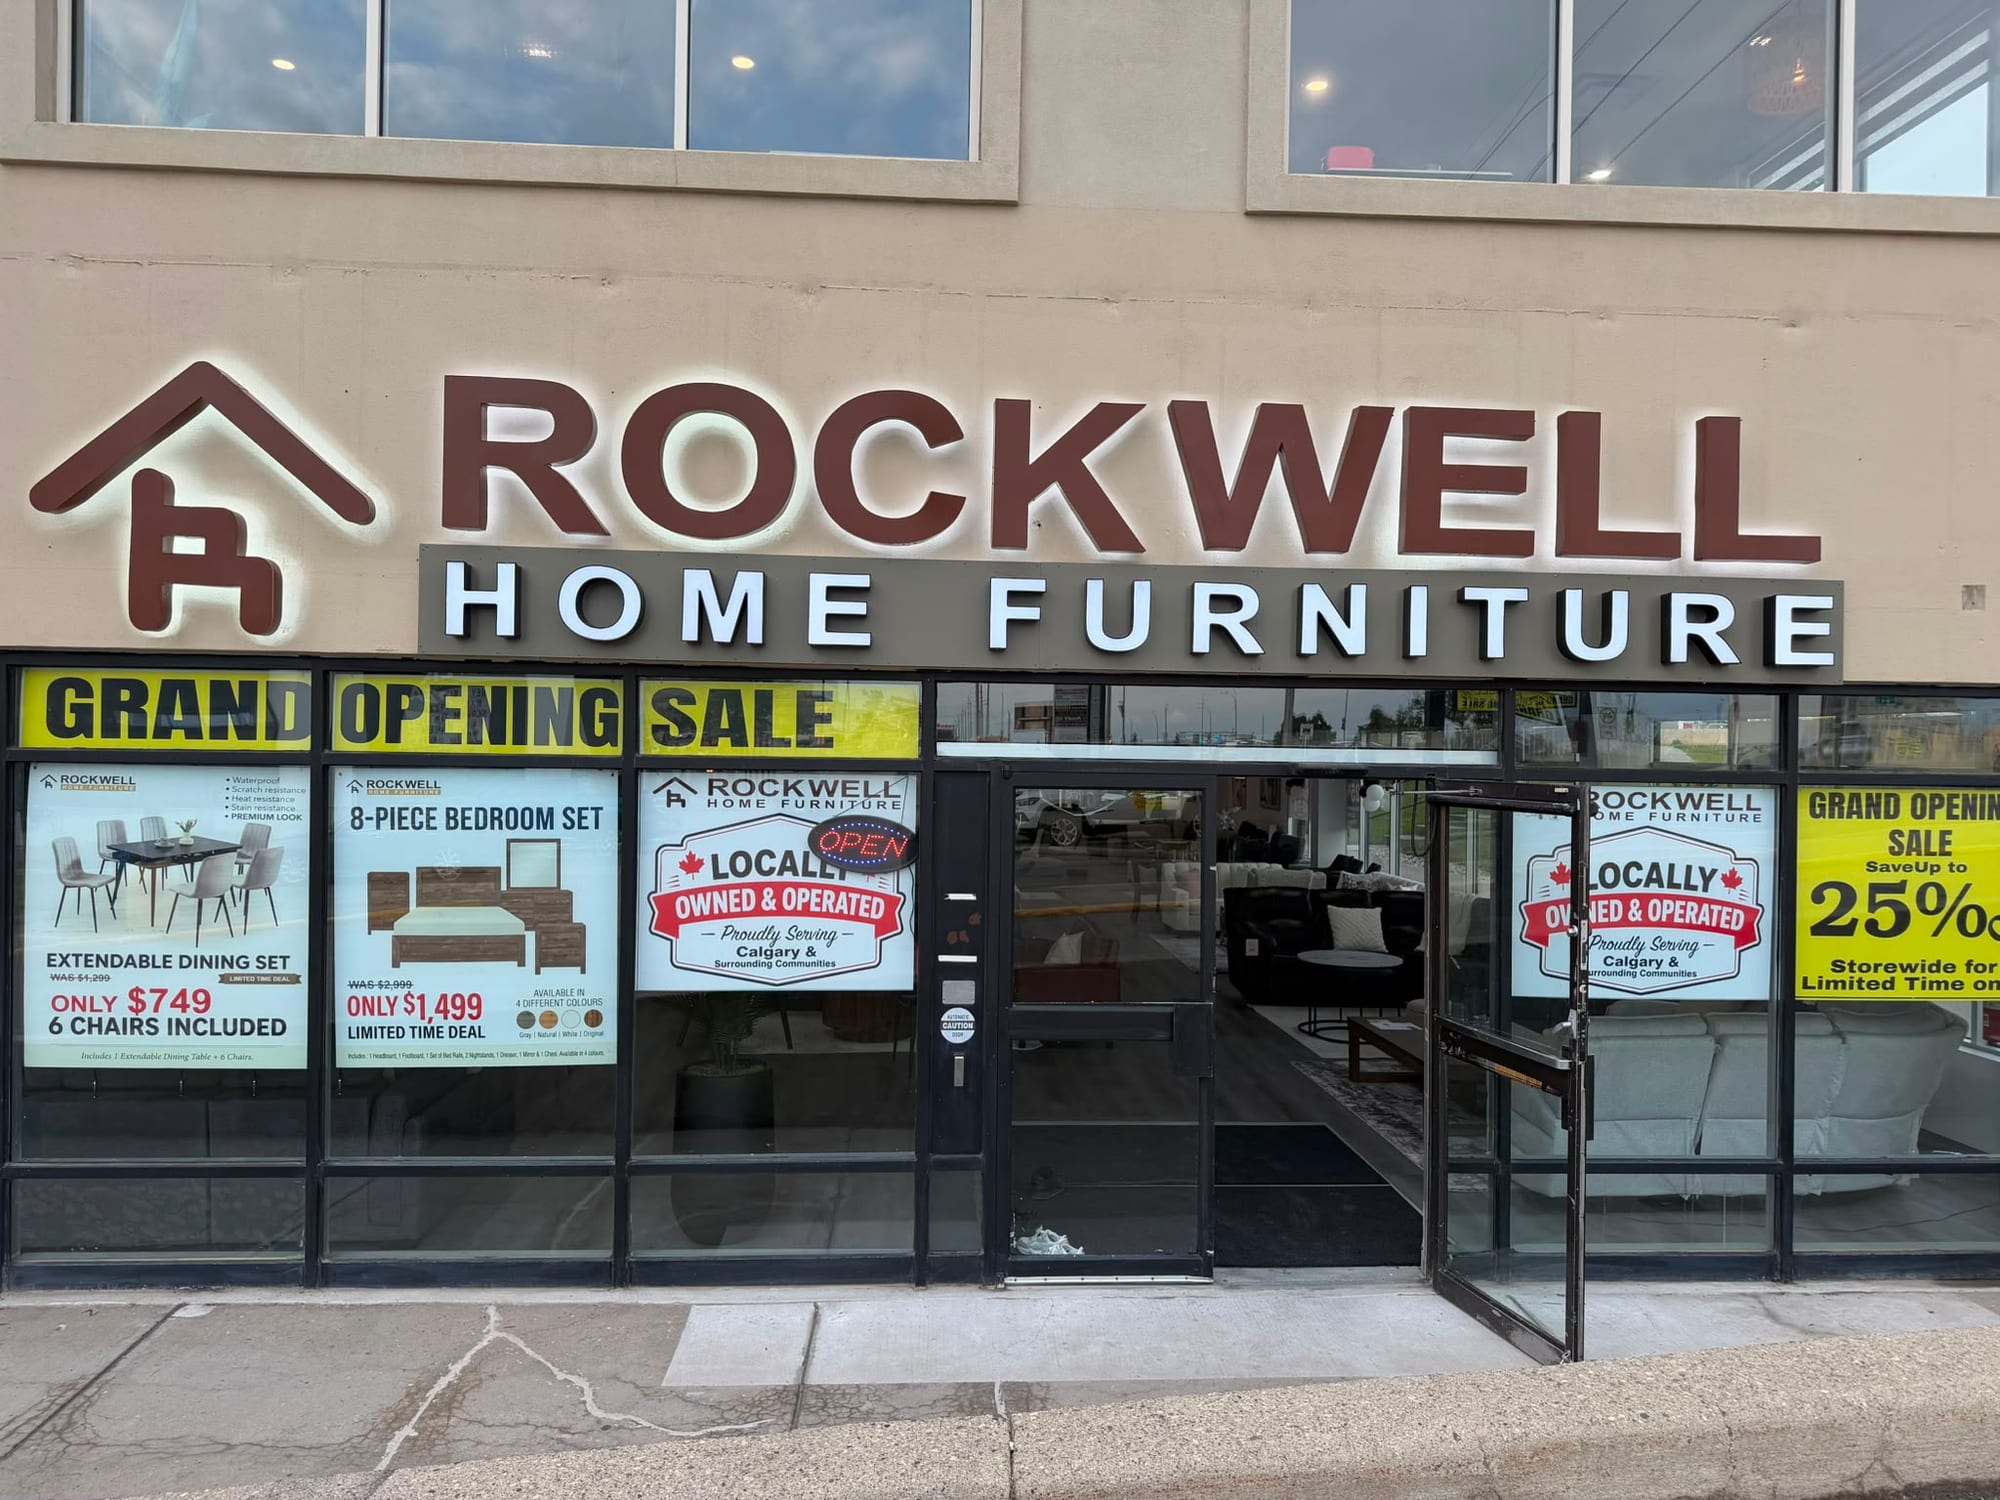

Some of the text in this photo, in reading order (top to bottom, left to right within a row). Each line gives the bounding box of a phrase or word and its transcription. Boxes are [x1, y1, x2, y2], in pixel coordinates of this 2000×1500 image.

[442, 375, 1821, 563] ROCKWELL
[445, 561, 1834, 667] HOME FURNITURE
[46, 677, 311, 741] GRAND
[339, 682, 621, 747] OPENING
[651, 688, 834, 748] SALE
[60, 774, 136, 785] ROCKWELL
[232, 777, 280, 785] Waterproof
[366, 780, 441, 788] ROCKWELL
[707, 778, 901, 798] ROCKWELL
[231, 803, 296, 812] Stain resistance
[707, 799, 901, 810] HOME FURNITURE
[1809, 792, 2000, 820] GRAND OPENIN
[231, 813, 303, 821] PREMIUM LOOK
[350, 806, 603, 831] 8-PIECE BEDROOM SET
[1594, 811, 1761, 823] OME FURNITURE
[819, 831, 909, 857] OPEN
[1888, 829, 1952, 857] SALE
[711, 850, 846, 881] LOCALL
[1866, 861, 1967, 876] SaveUp to
[675, 888, 885, 919] OWNED & OPERATED
[1810, 880, 1987, 938] 25%
[1627, 898, 1643, 921] &
[1648, 898, 1744, 931] OPERATED
[720, 925, 838, 948] Proudly Serving
[736, 946, 817, 960] Calgary &
[1588, 935, 1699, 959] Proudly Serving
[47, 953, 290, 970] EXTENDABLE DINING SET
[714, 959, 836, 969] Surrounding Communities
[1603, 955, 1679, 970] Calgary &
[1831, 959, 1998, 974] Storewide for
[1588, 968, 1697, 979] urrounding Communities
[348, 980, 413, 991] WAS $2,999
[1802, 976, 1895, 990] Limited
[1904, 976, 1965, 991] Time
[533, 988, 585, 997] AVAILABLE IN
[51, 986, 212, 1016] ONLY $749
[347, 991, 483, 1024] ONLY $1,499
[522, 999, 564, 1007] DIFFERENT
[566, 998, 603, 1006] COLOURS
[48, 1017, 287, 1036] 6 CHAIRS INCLUDED
[348, 1026, 486, 1039] LIMITED TIME DEAL
[583, 1030, 604, 1038] Original
[81, 1052, 112, 1060] Includes
[120, 1052, 161, 1060] Extendable
[163, 1052, 189, 1062] Dining
[191, 1053, 211, 1061] Table
[227, 1053, 253, 1061] Chairs.
